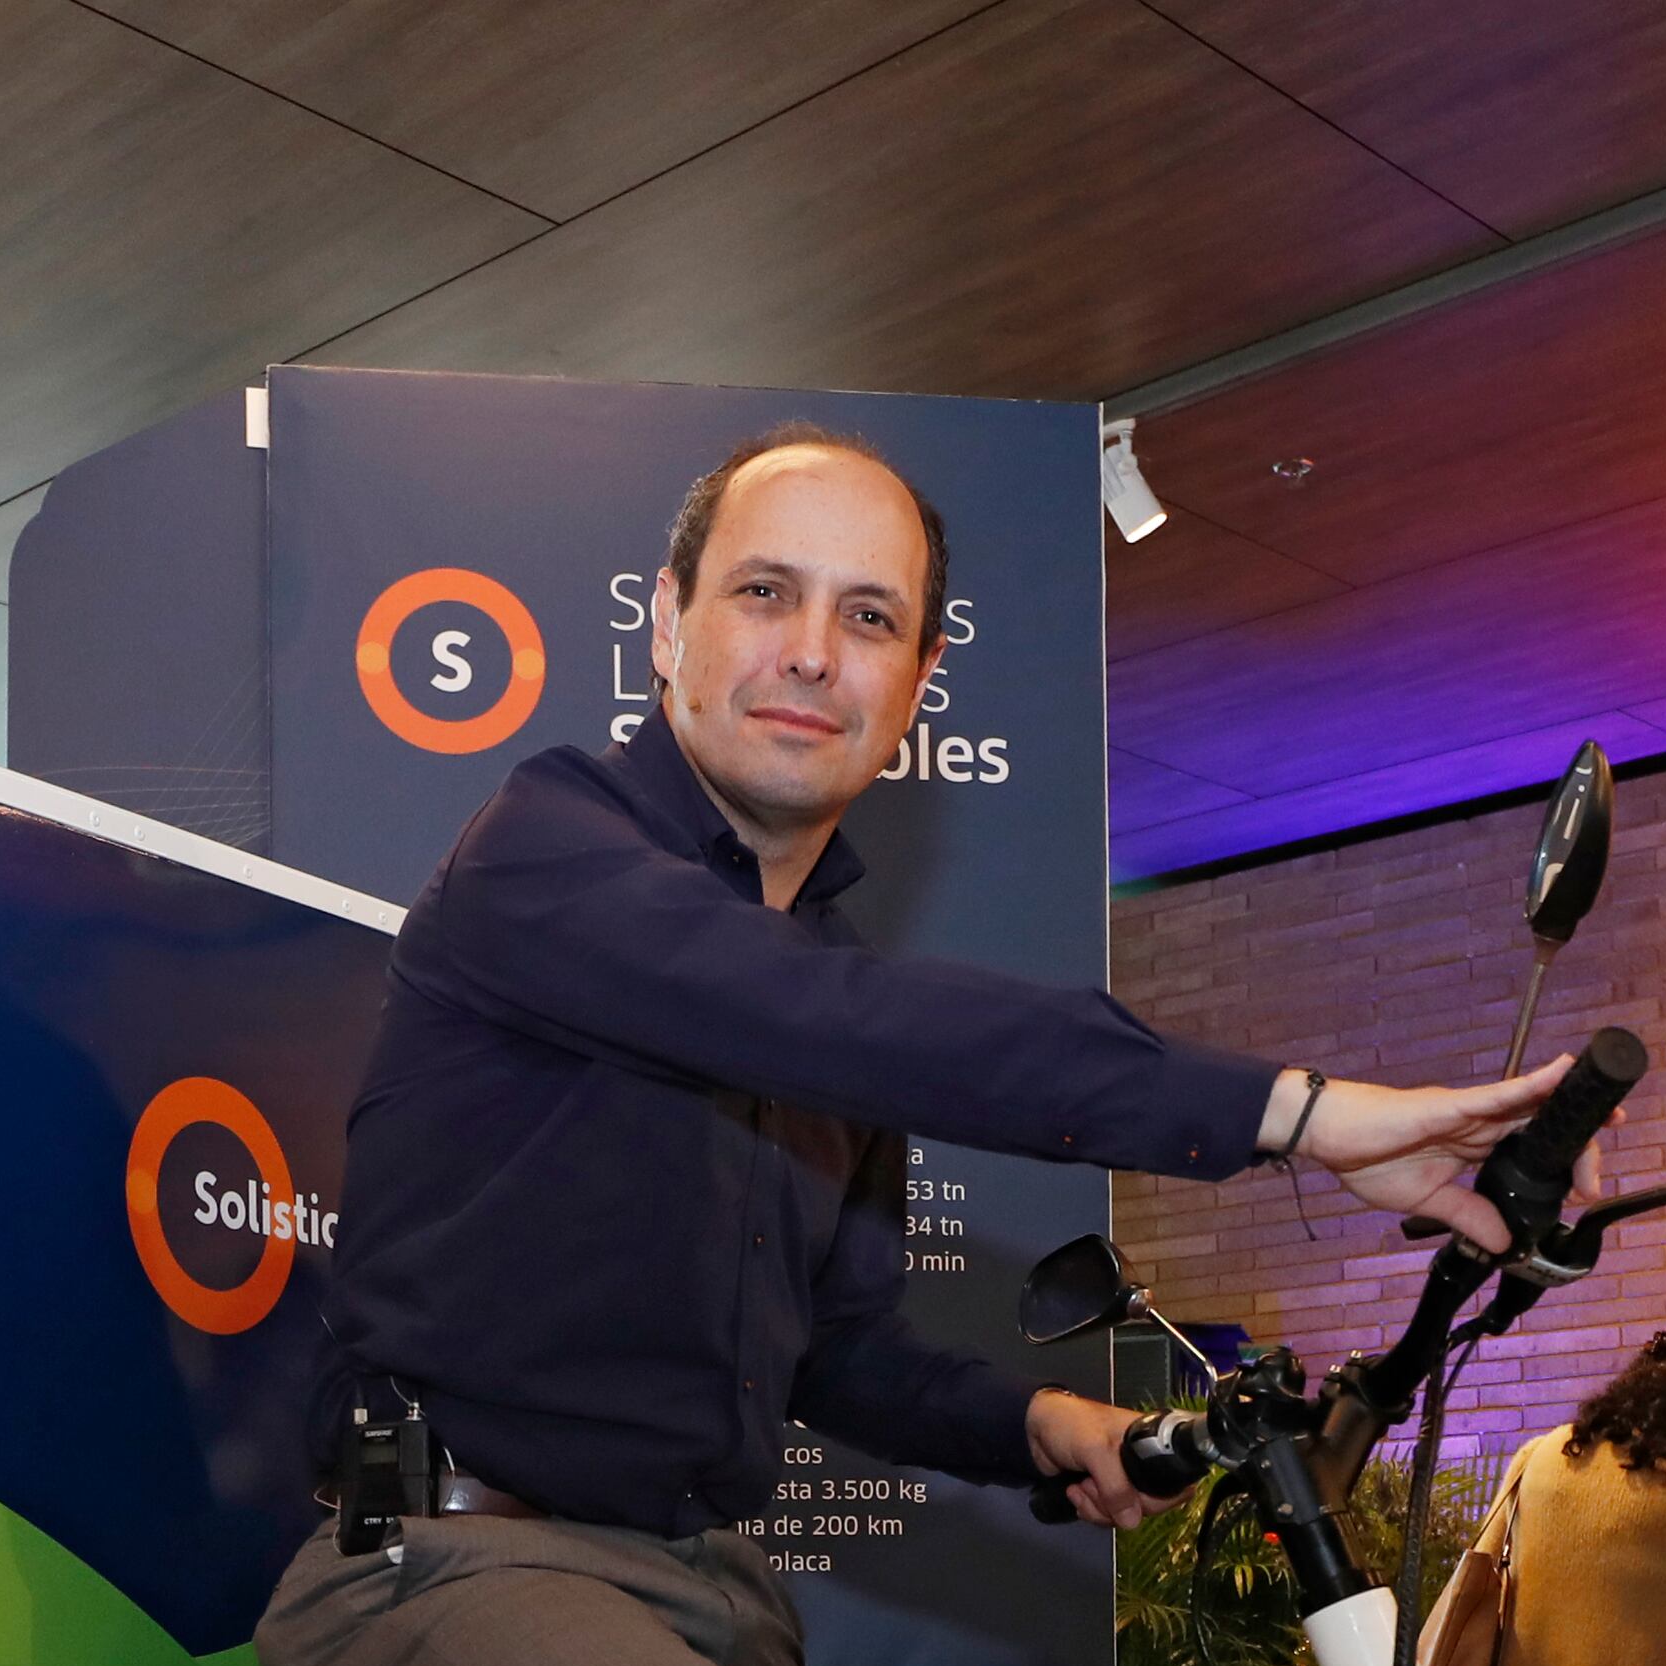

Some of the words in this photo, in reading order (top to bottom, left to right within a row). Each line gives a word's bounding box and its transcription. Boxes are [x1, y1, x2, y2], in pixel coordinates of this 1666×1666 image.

[429, 629, 474, 694] S
[942, 1181, 965, 1201] tn
[940, 1216, 963, 1236] tn
[922, 1251, 965, 1272] min
[773, 1480, 812, 1500] sta
[821, 1479, 890, 1500] 3.500
[900, 1479, 927, 1503] kg
[774, 1515, 803, 1536] de
[812, 1515, 859, 1536] 200
[868, 1514, 903, 1535] km
